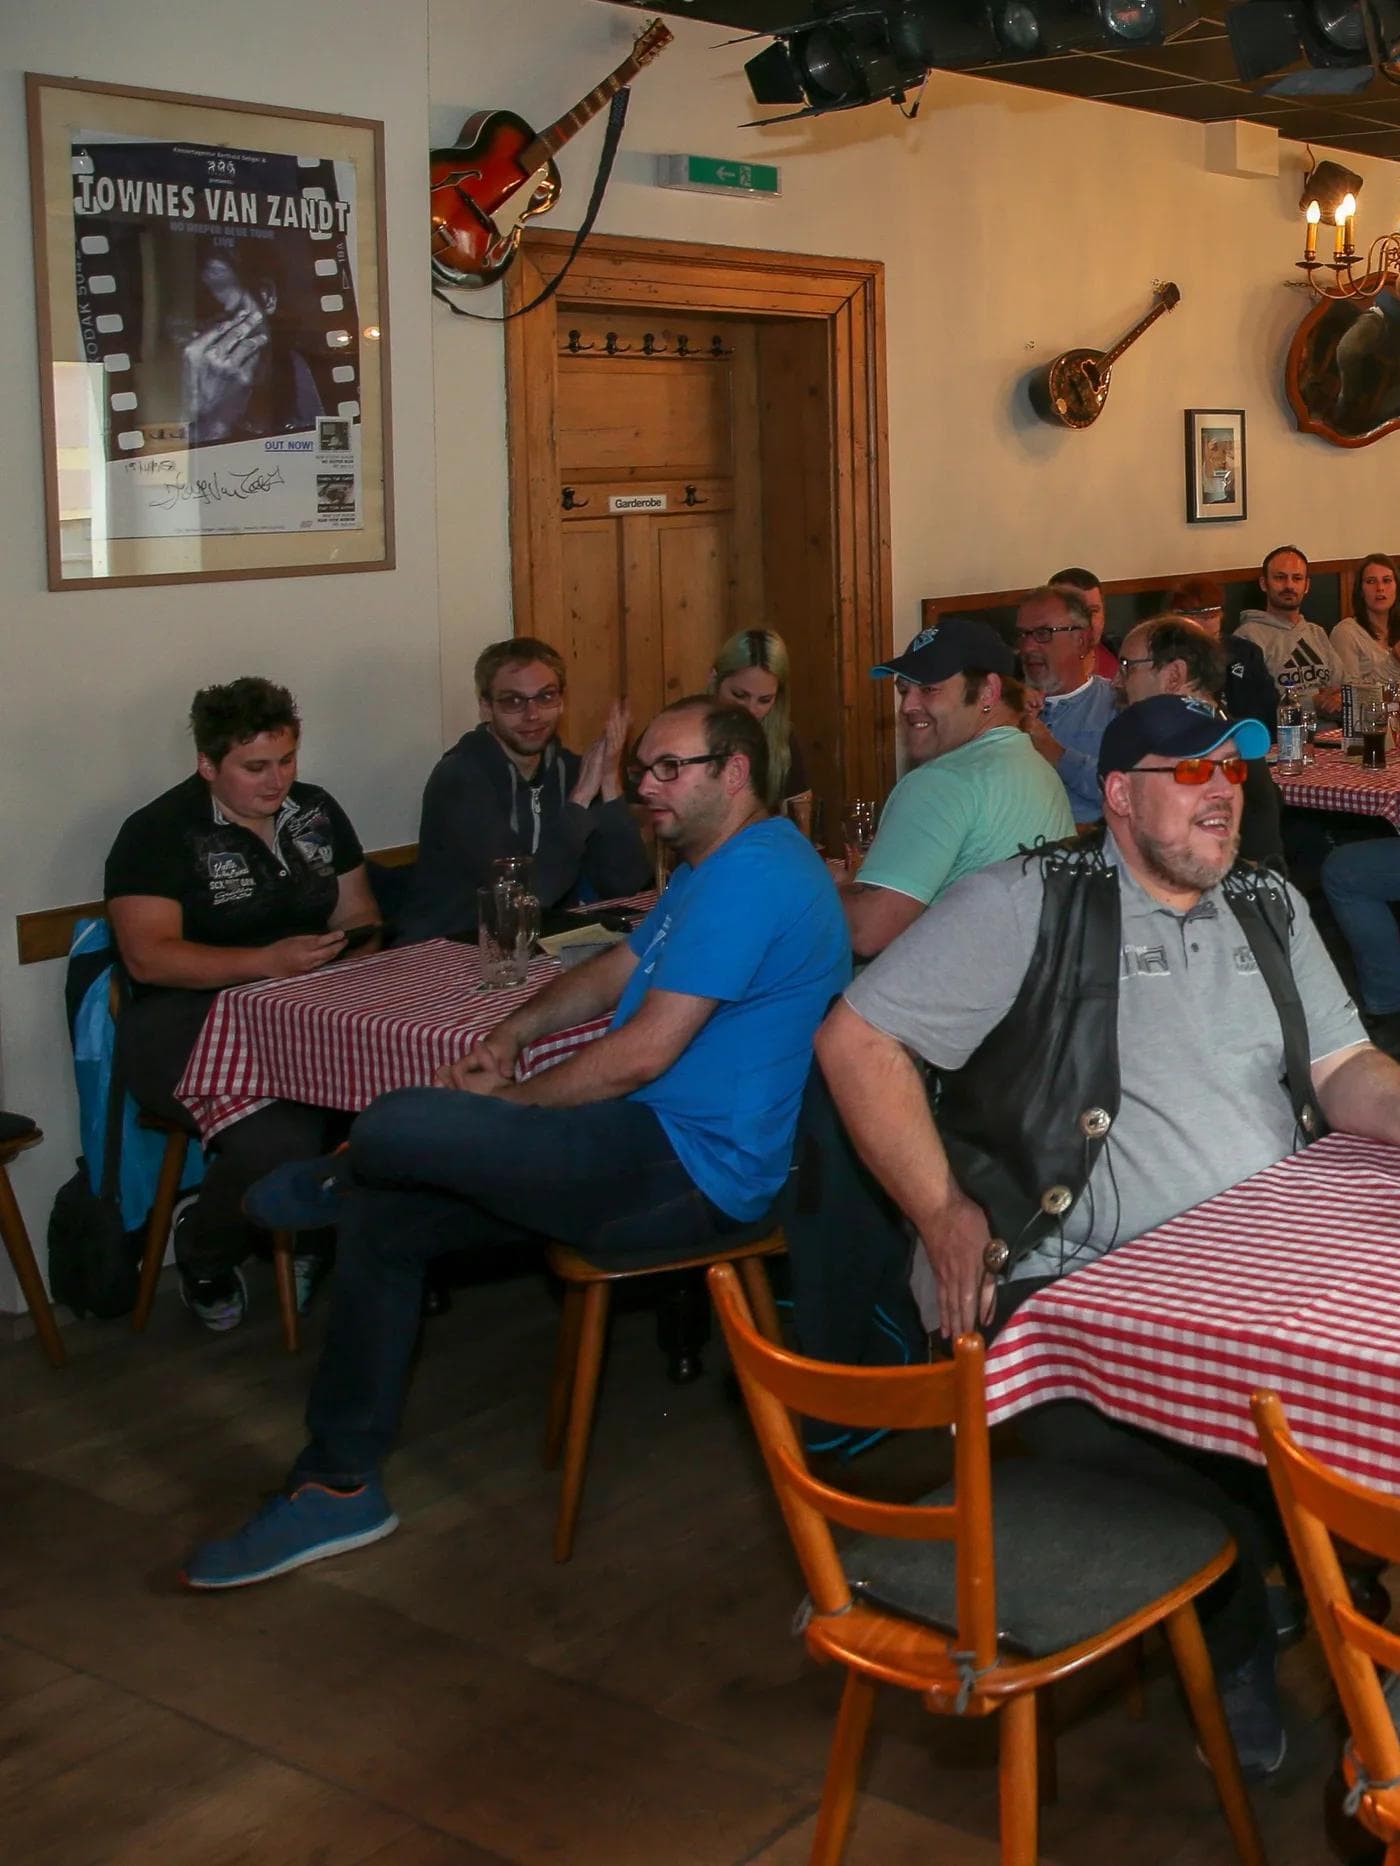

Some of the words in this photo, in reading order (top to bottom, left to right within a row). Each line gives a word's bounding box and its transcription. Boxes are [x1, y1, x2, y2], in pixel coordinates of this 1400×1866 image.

[78, 175, 196, 219] TOWNES
[203, 188, 257, 224] VAN
[266, 195, 349, 233] ZANDT
[264, 441, 284, 450] OUT
[288, 440, 313, 450] NOW!
[615, 498, 661, 508] Garderobe
